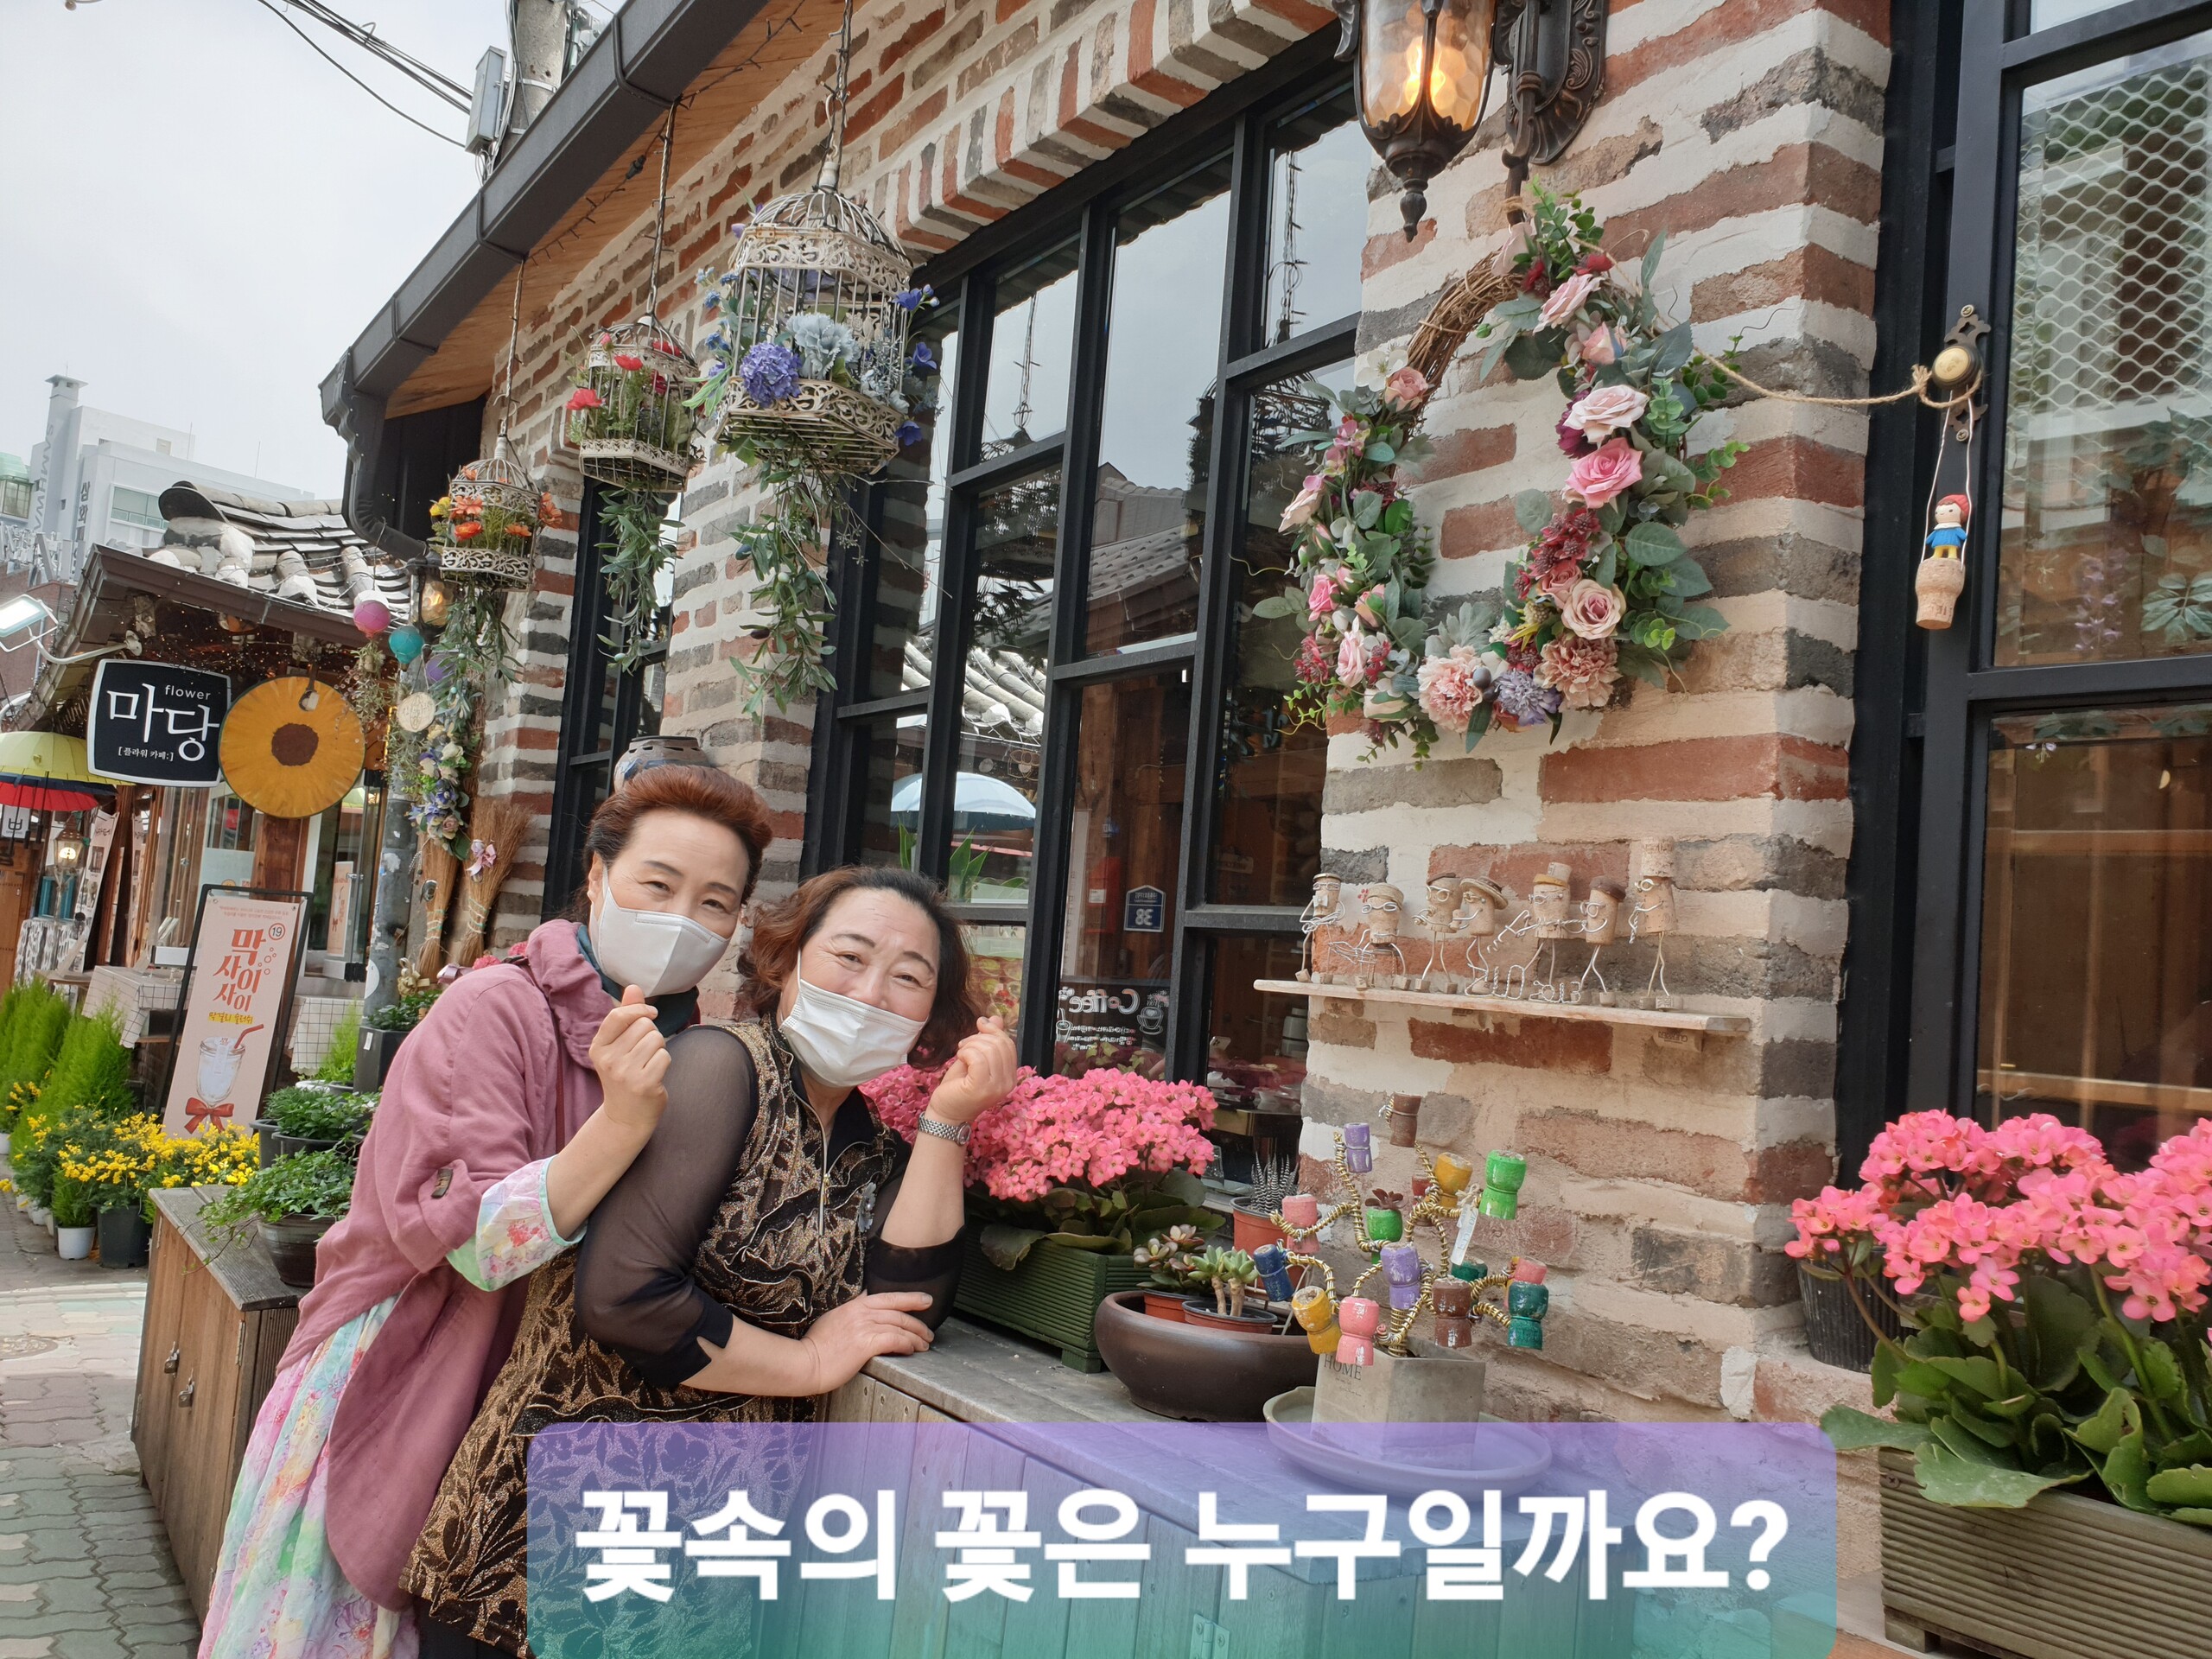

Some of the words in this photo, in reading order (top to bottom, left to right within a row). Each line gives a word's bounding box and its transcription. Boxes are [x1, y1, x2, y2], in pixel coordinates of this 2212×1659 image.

[165, 684, 212, 701] flower
[107, 683, 220, 762] 마당
[231, 928, 267, 967] 막
[271, 926, 283, 938] 19
[213, 955, 263, 995] 사이
[213, 982, 252, 1013] 사이
[1324, 1352, 1363, 1381] HOME
